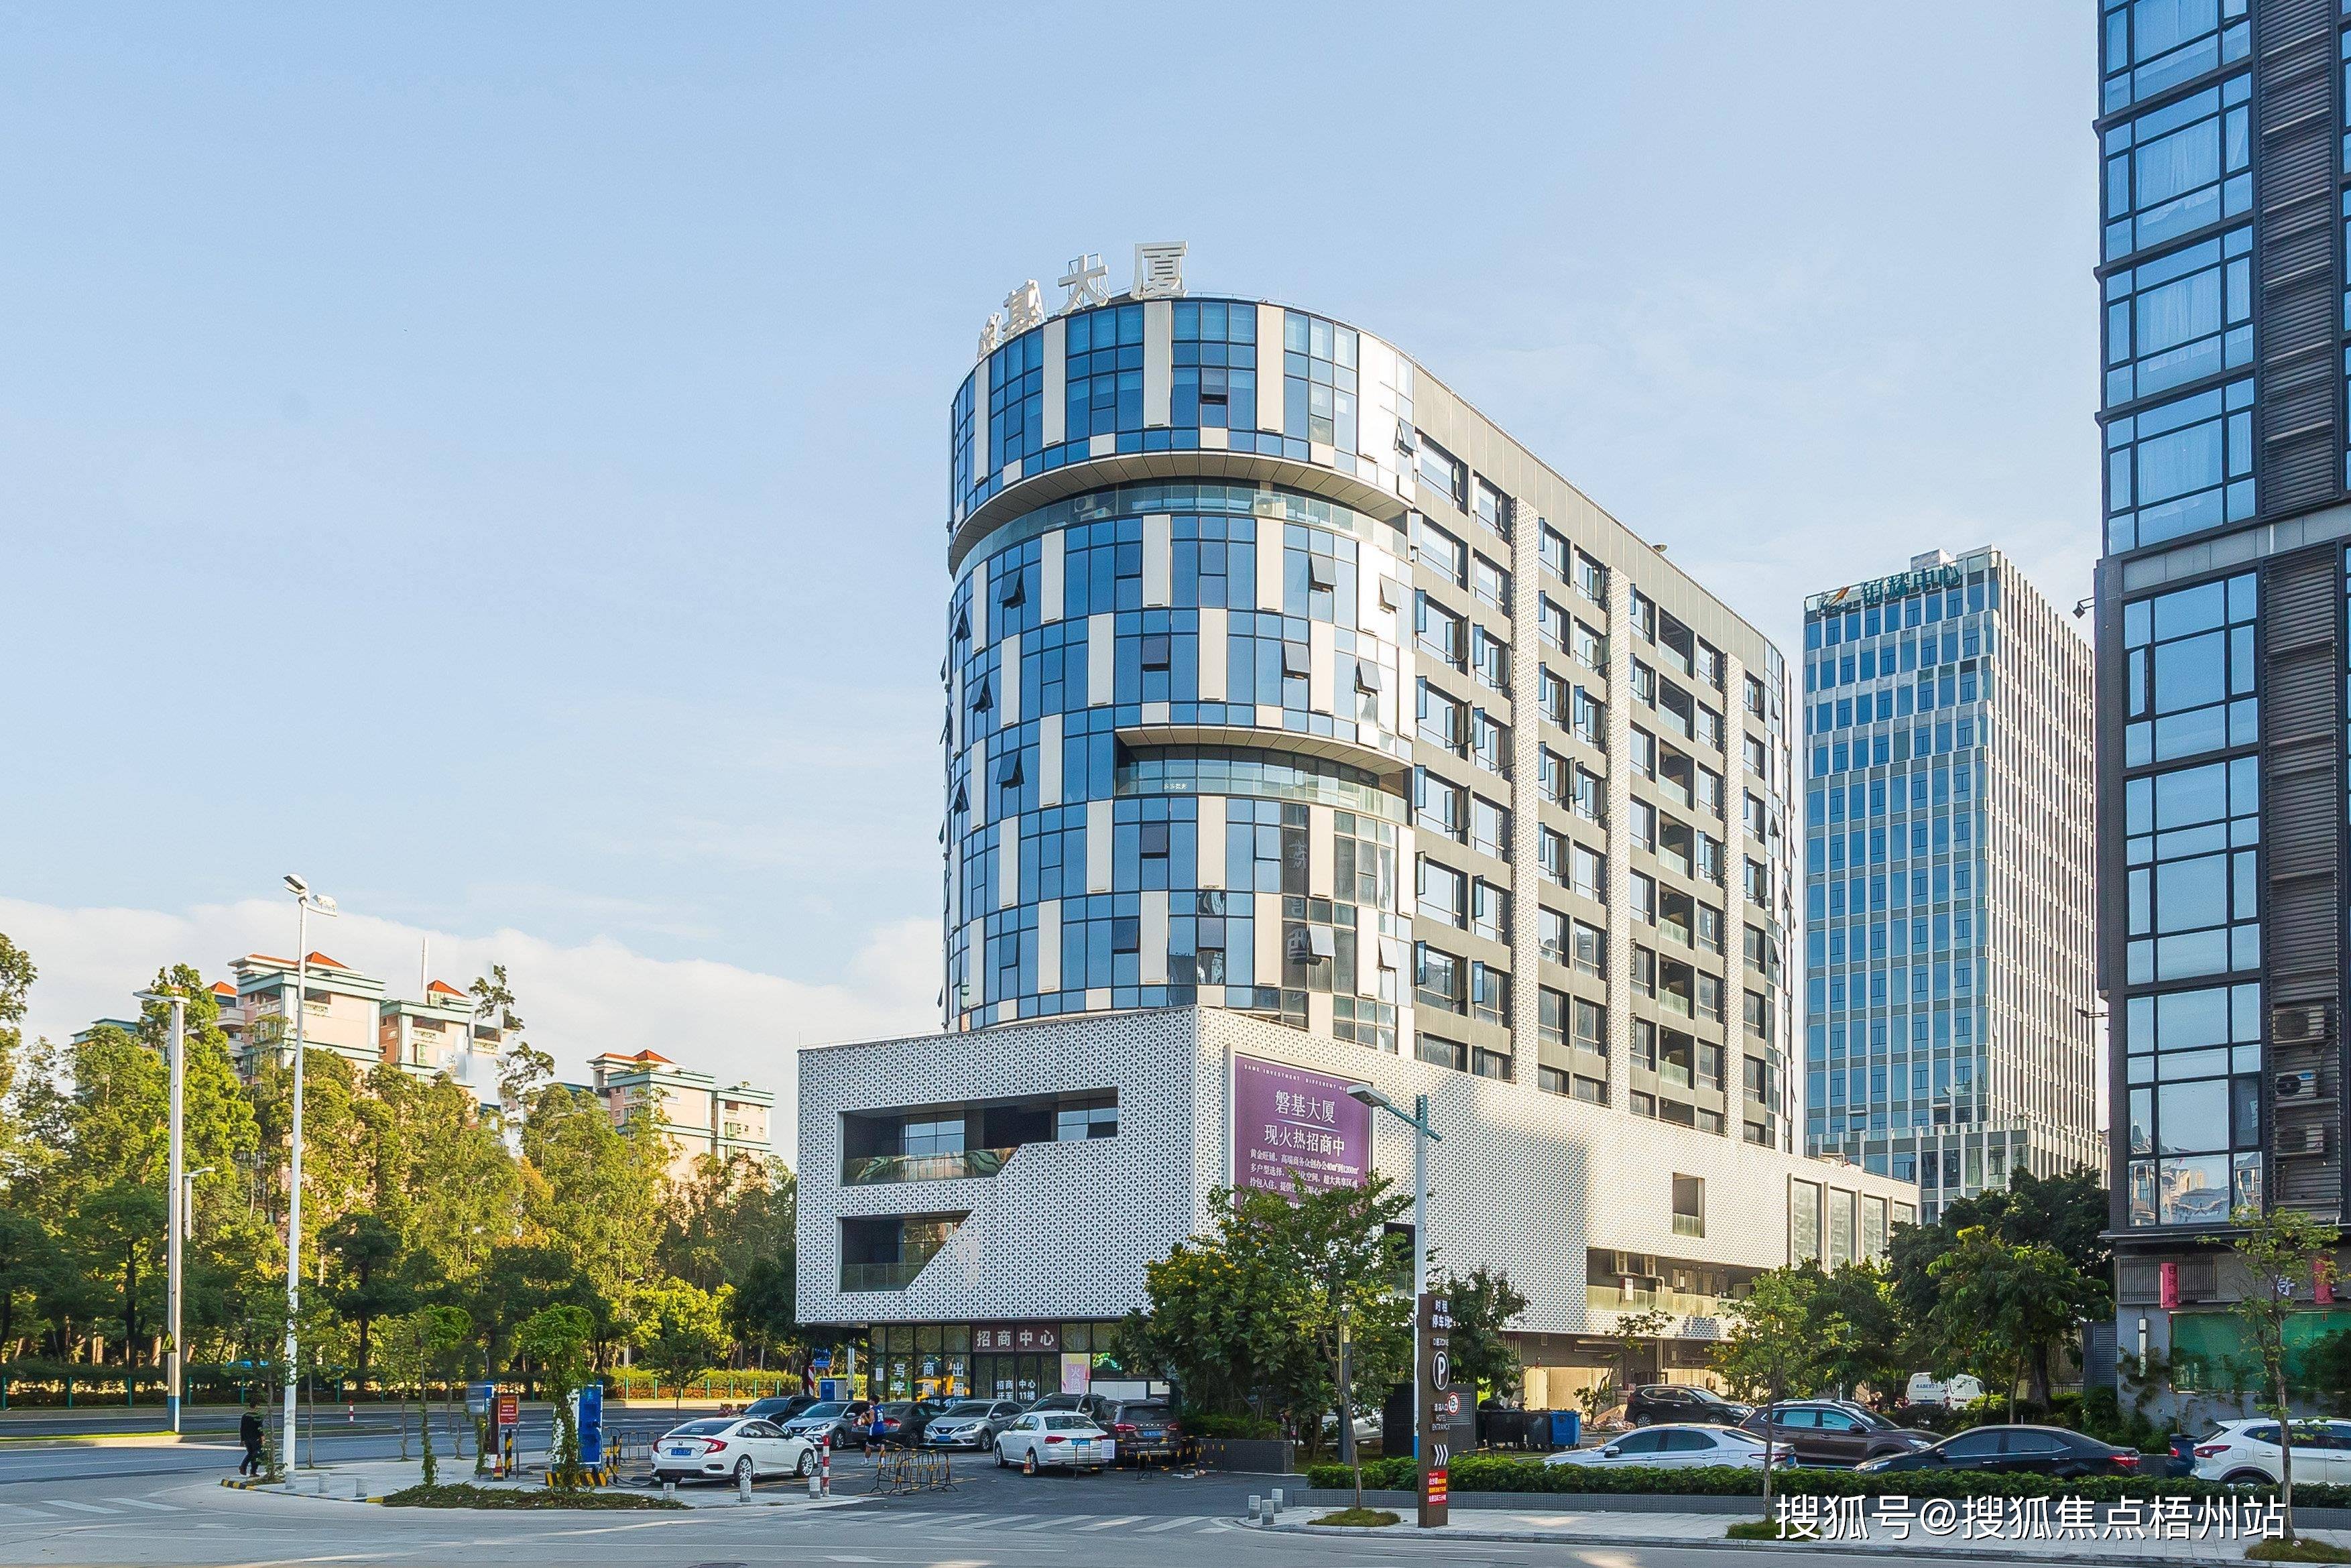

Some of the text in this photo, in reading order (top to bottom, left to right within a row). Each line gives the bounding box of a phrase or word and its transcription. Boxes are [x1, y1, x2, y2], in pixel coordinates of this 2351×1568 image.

[1263, 1069, 1300, 1081] INVESTMENT
[1305, 1078, 1336, 1089] DIFFERENT
[1274, 1090, 1336, 1124] 磐基大厦
[1264, 1124, 1345, 1157] 现火热招商中
[977, 1329, 1054, 1347] 招商中心
[894, 1364, 905, 1402] 写字
[953, 1362, 965, 1396] 出租
[997, 1379, 1036, 1390] 招商中心
